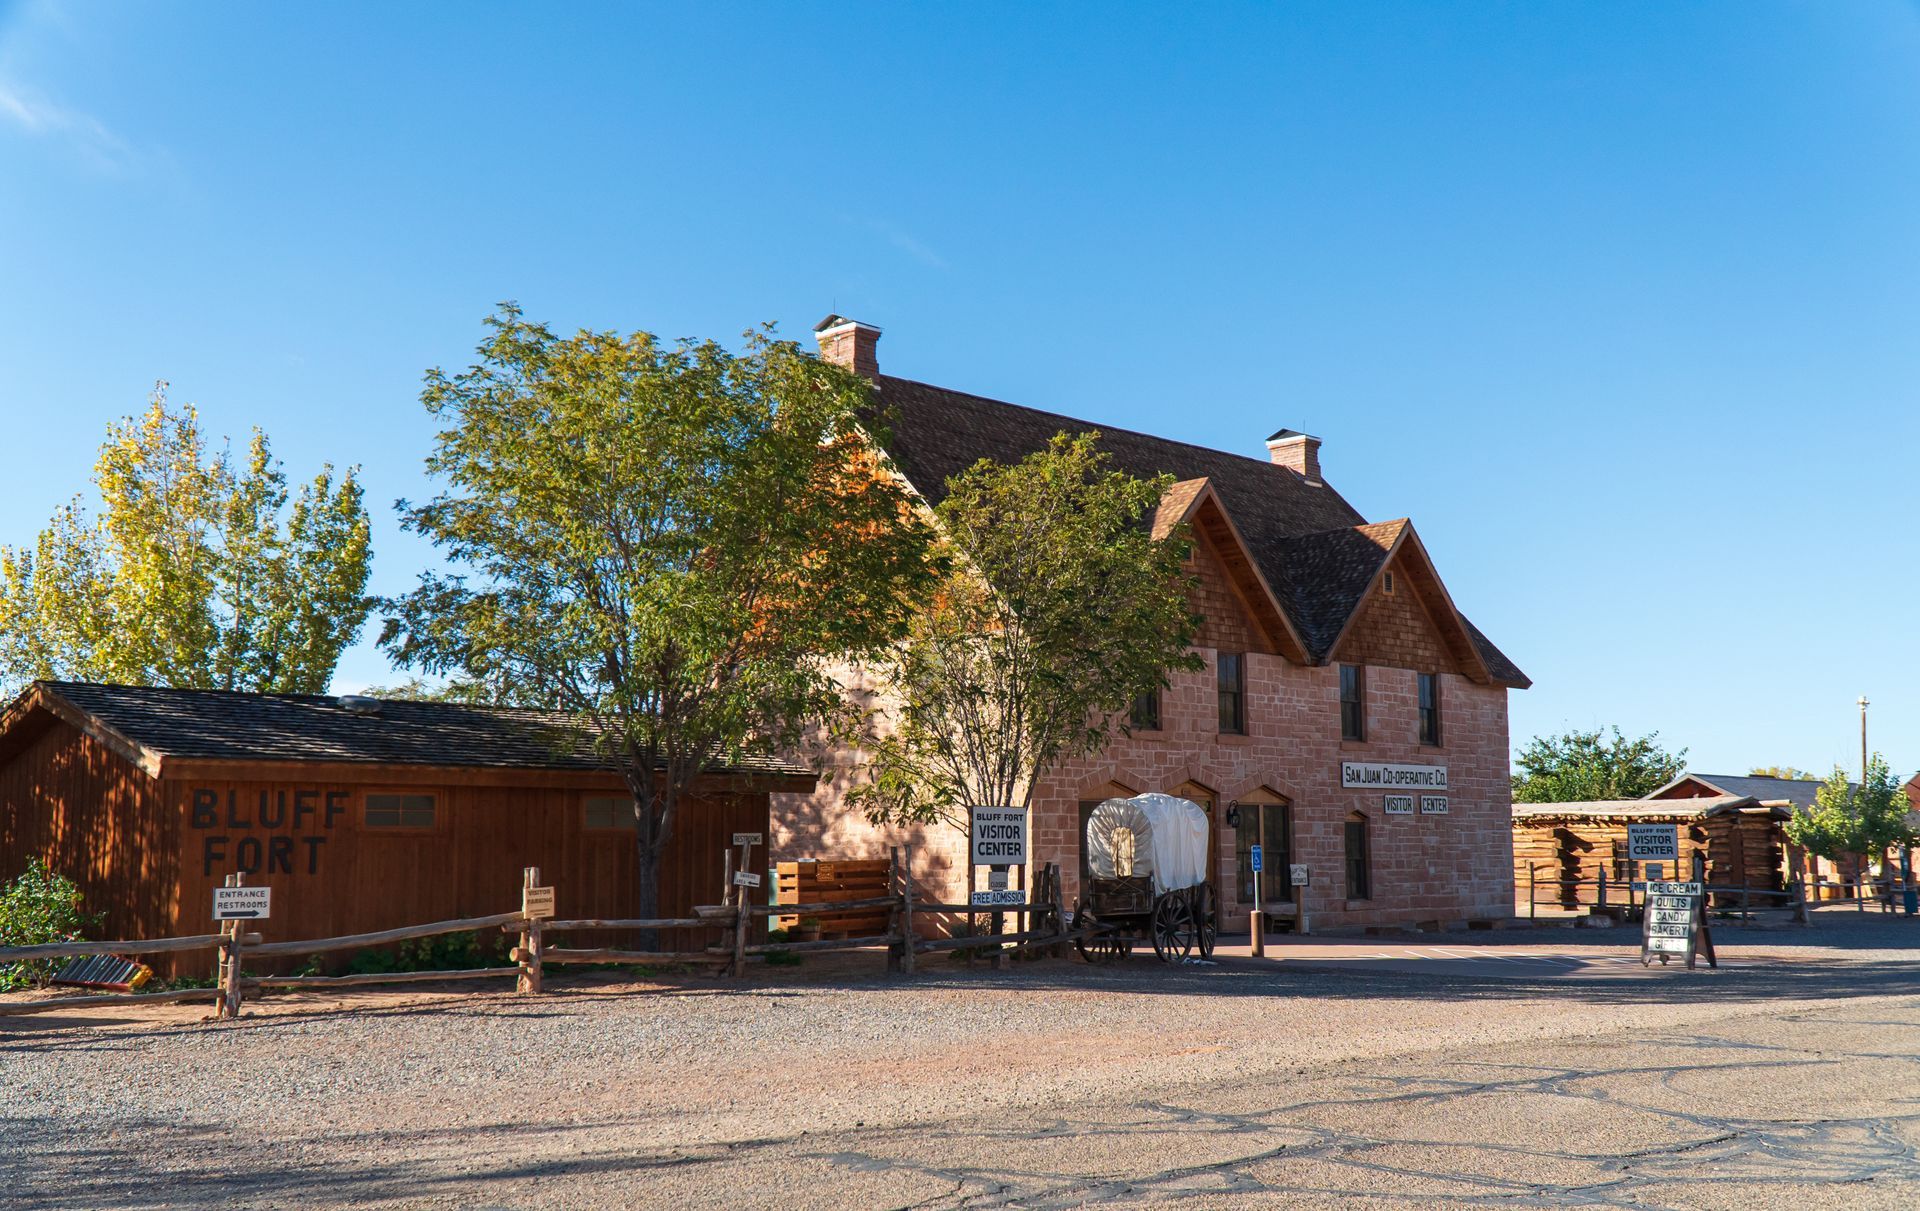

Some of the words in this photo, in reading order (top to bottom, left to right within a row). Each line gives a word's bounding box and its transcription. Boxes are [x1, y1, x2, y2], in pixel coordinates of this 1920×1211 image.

[1345, 765, 1361, 783] SAN
[1362, 767, 1381, 784] JUAN
[191, 788, 351, 830] BLUFF
[1386, 797, 1412, 811] VISITOR
[1422, 797, 1447, 812] CENTER
[976, 813, 1001, 821] BLUFF
[1004, 813, 1024, 821] FORT
[979, 824, 1021, 840] VISITOR
[1633, 835, 1673, 845] VISITOR
[977, 842, 1022, 856] CENTER
[1633, 845, 1674, 855] CENTER
[203, 835, 327, 877] FORT
[219, 890, 266, 898] ENTRANCE
[1649, 883, 1664, 893] ICE
[1666, 883, 1699, 894] CREAM
[972, 892, 991, 904] FREE
[992, 890, 1026, 904] ADMISSION
[1656, 897, 1687, 908] QUILTS
[217, 901, 268, 909] RESTROOMS
[1655, 911, 1685, 921] CANDY
[1651, 925, 1688, 936] BAKERY
